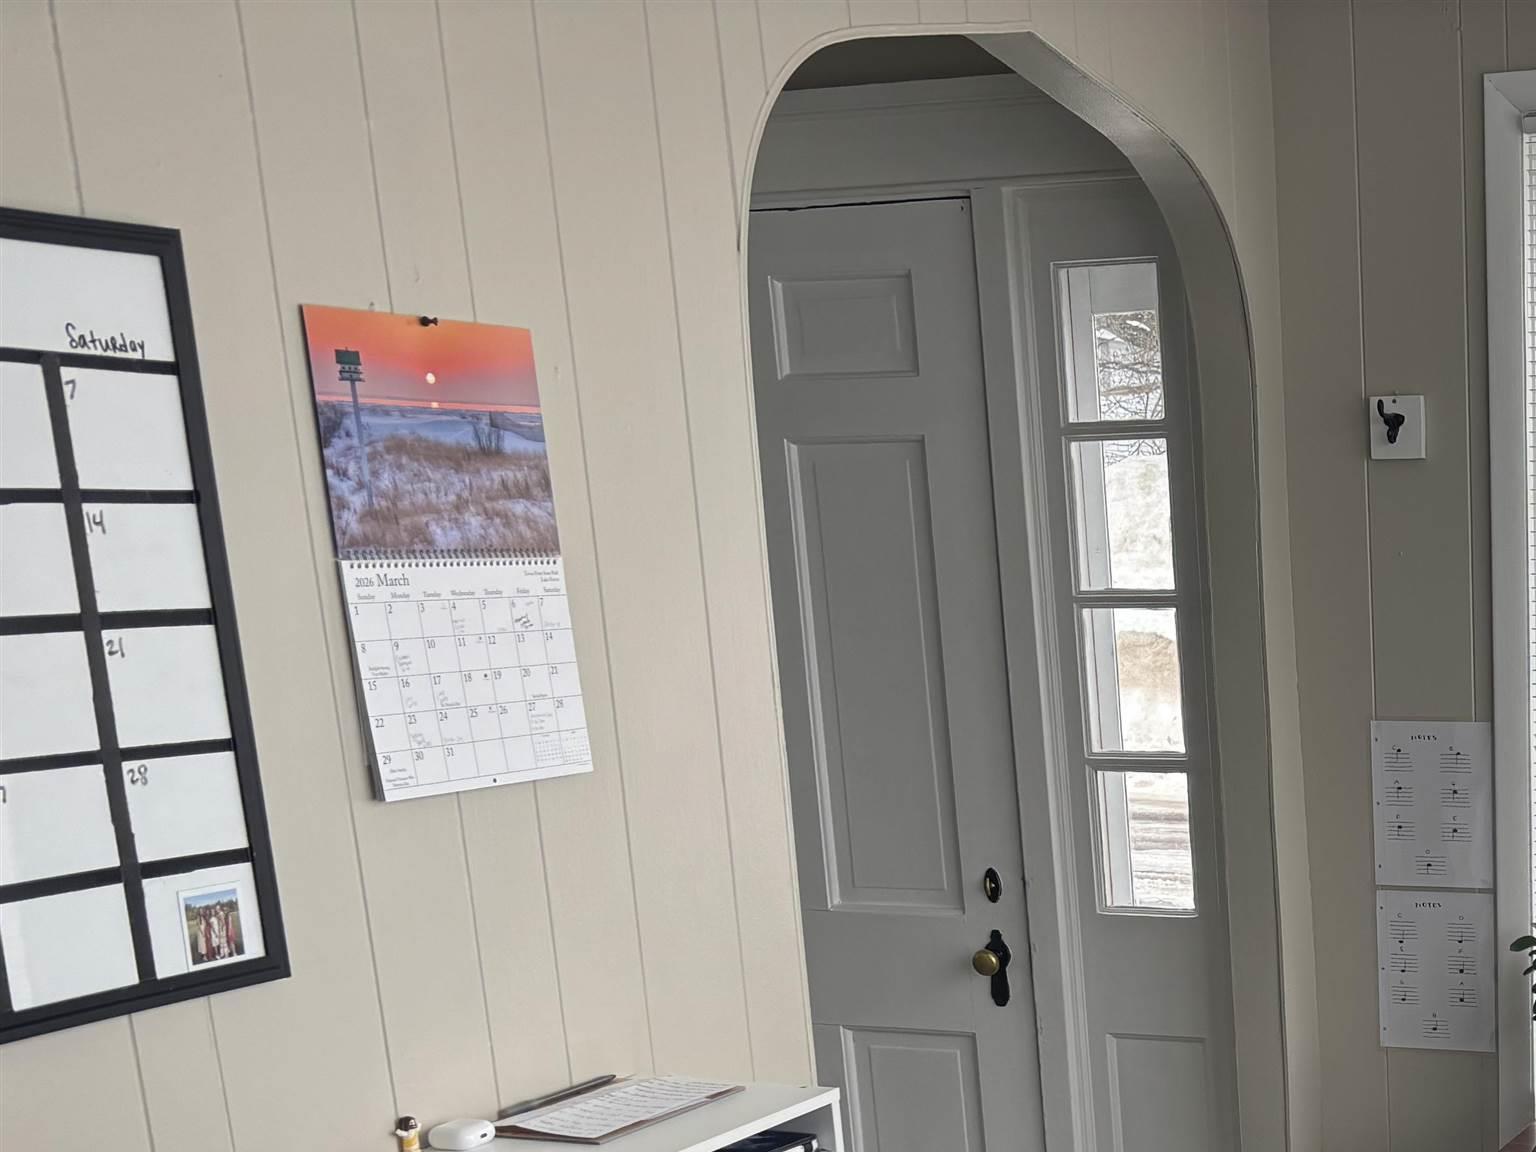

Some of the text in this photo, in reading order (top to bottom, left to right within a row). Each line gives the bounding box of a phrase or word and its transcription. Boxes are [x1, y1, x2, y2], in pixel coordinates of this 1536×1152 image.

[65, 323, 145, 358] Saturday
[64, 379, 76, 400] 7
[86, 510, 106, 535] 14
[355, 573, 410, 587] 2026 March
[354, 606, 359, 615] 1
[388, 604, 393, 614] 2
[420, 603, 425, 613] 3
[451, 602, 456, 611] 4
[482, 600, 487, 609] 5
[106, 637, 125, 658] 21
[394, 641, 399, 651] 9
[426, 639, 436, 649] 10
[458, 637, 466, 647] 11
[488, 635, 496, 644] 12
[545, 632, 553, 640] 14
[368, 681, 377, 691] 15
[401, 678, 410, 688] 16
[433, 675, 441, 685] 17
[464, 673, 472, 682] 18
[493, 671, 502, 680] 19
[522, 668, 531, 677] 20
[375, 718, 384, 728] 22
[408, 715, 417, 725] 23
[439, 712, 448, 721] 24
[469, 708, 478, 718] 25
[382, 747, 454, 765] 29 30 31
[127, 764, 148, 786] 28
